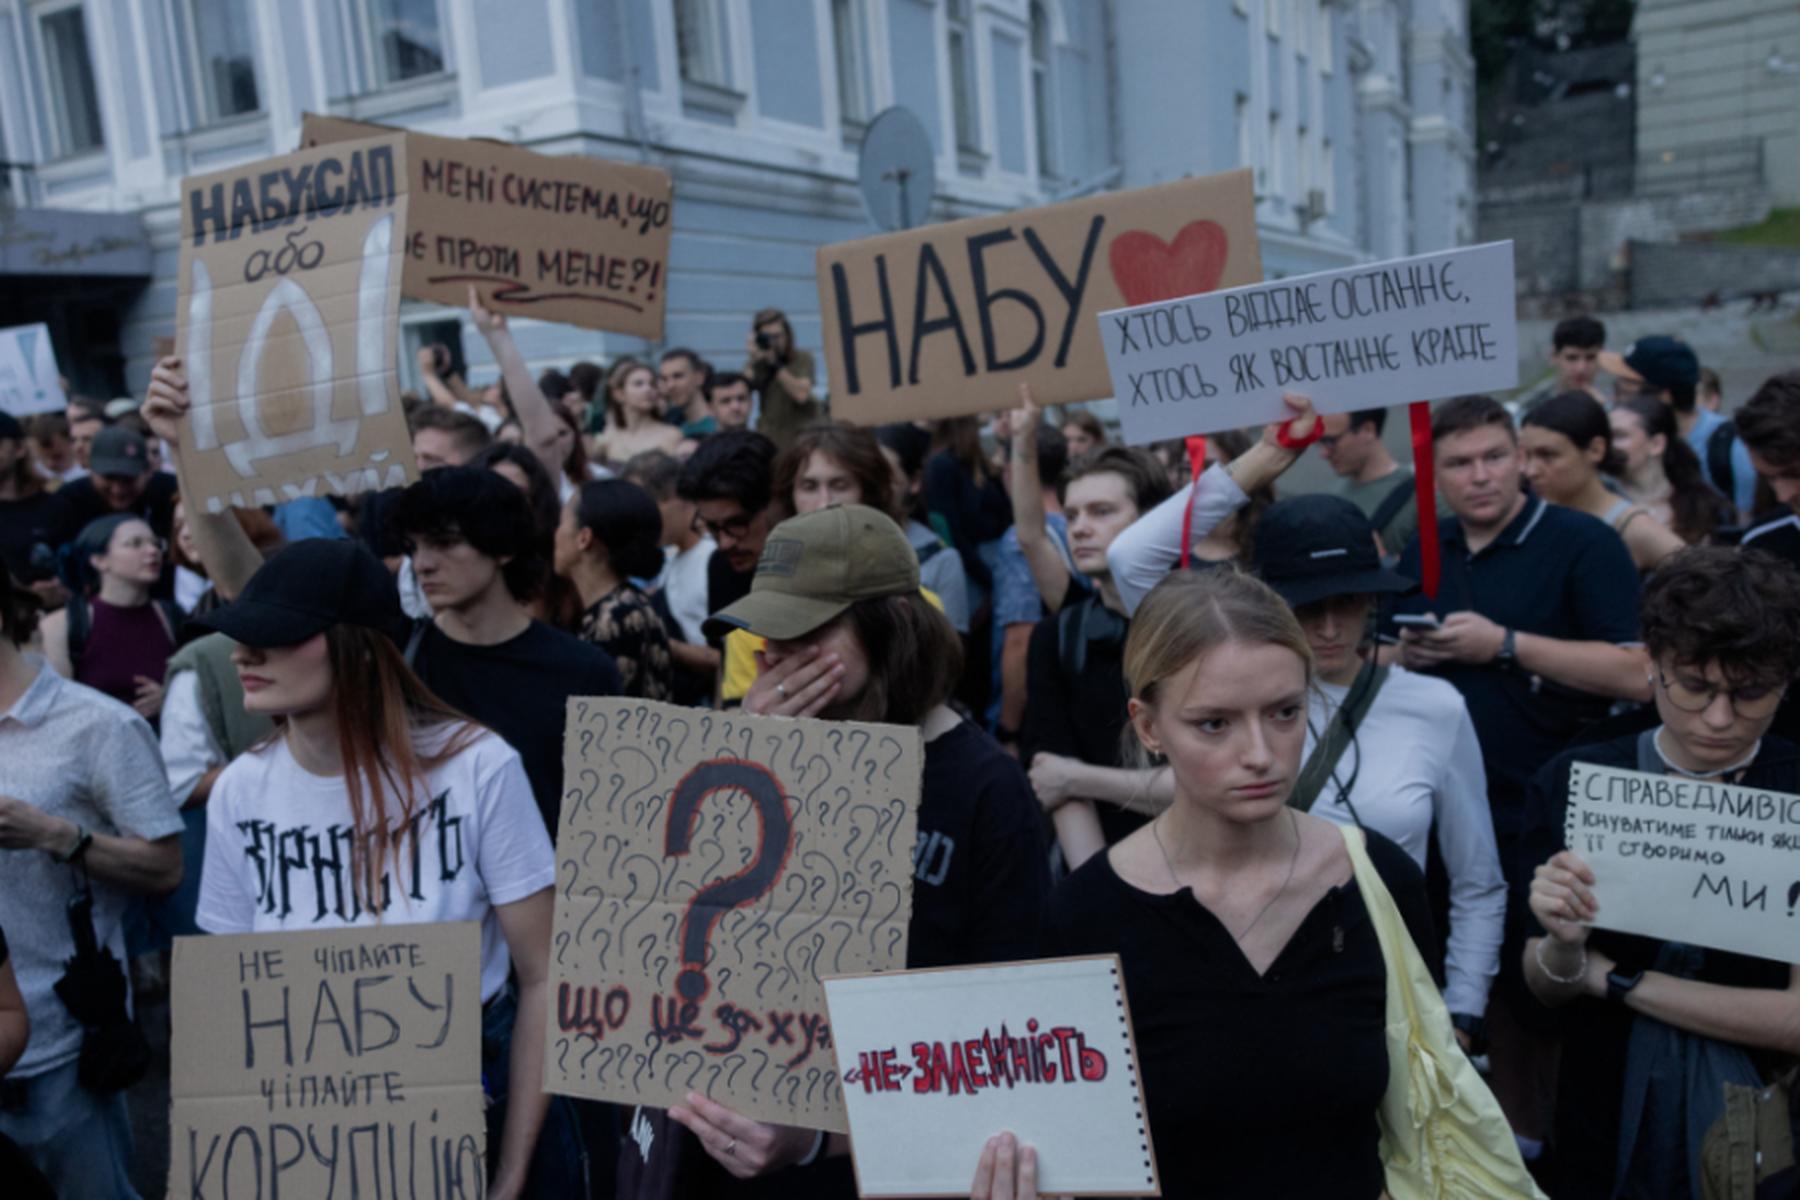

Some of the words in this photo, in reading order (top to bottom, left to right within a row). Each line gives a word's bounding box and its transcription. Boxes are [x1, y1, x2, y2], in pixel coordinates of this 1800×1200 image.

[244, 226, 325, 282] або
[436, 235, 520, 277] ПРОТИ
[537, 248, 661, 301] МЕНЕ?!
[831, 214, 1105, 395] НАБУ
[1114, 306, 1212, 354] ХТОСЬ
[1225, 283, 1327, 338] ВІДДАЄ
[1331, 262, 1471, 320] ОСТАННЄ,
[1128, 363, 1218, 407] ХТОСЬ
[1228, 353, 1265, 394] ЯК
[1270, 335, 1400, 386] ВОСТАННЄ
[1411, 323, 1497, 367] КРАДЕ
[1582, 810, 1696, 840] ІСНУВАТИМЕ
[1706, 825, 1764, 848] ТІЛЬКИ
[1619, 840, 1725, 865] СТВОРИМО
[239, 950, 284, 983] НЕ
[242, 974, 453, 1069] НАБУ
